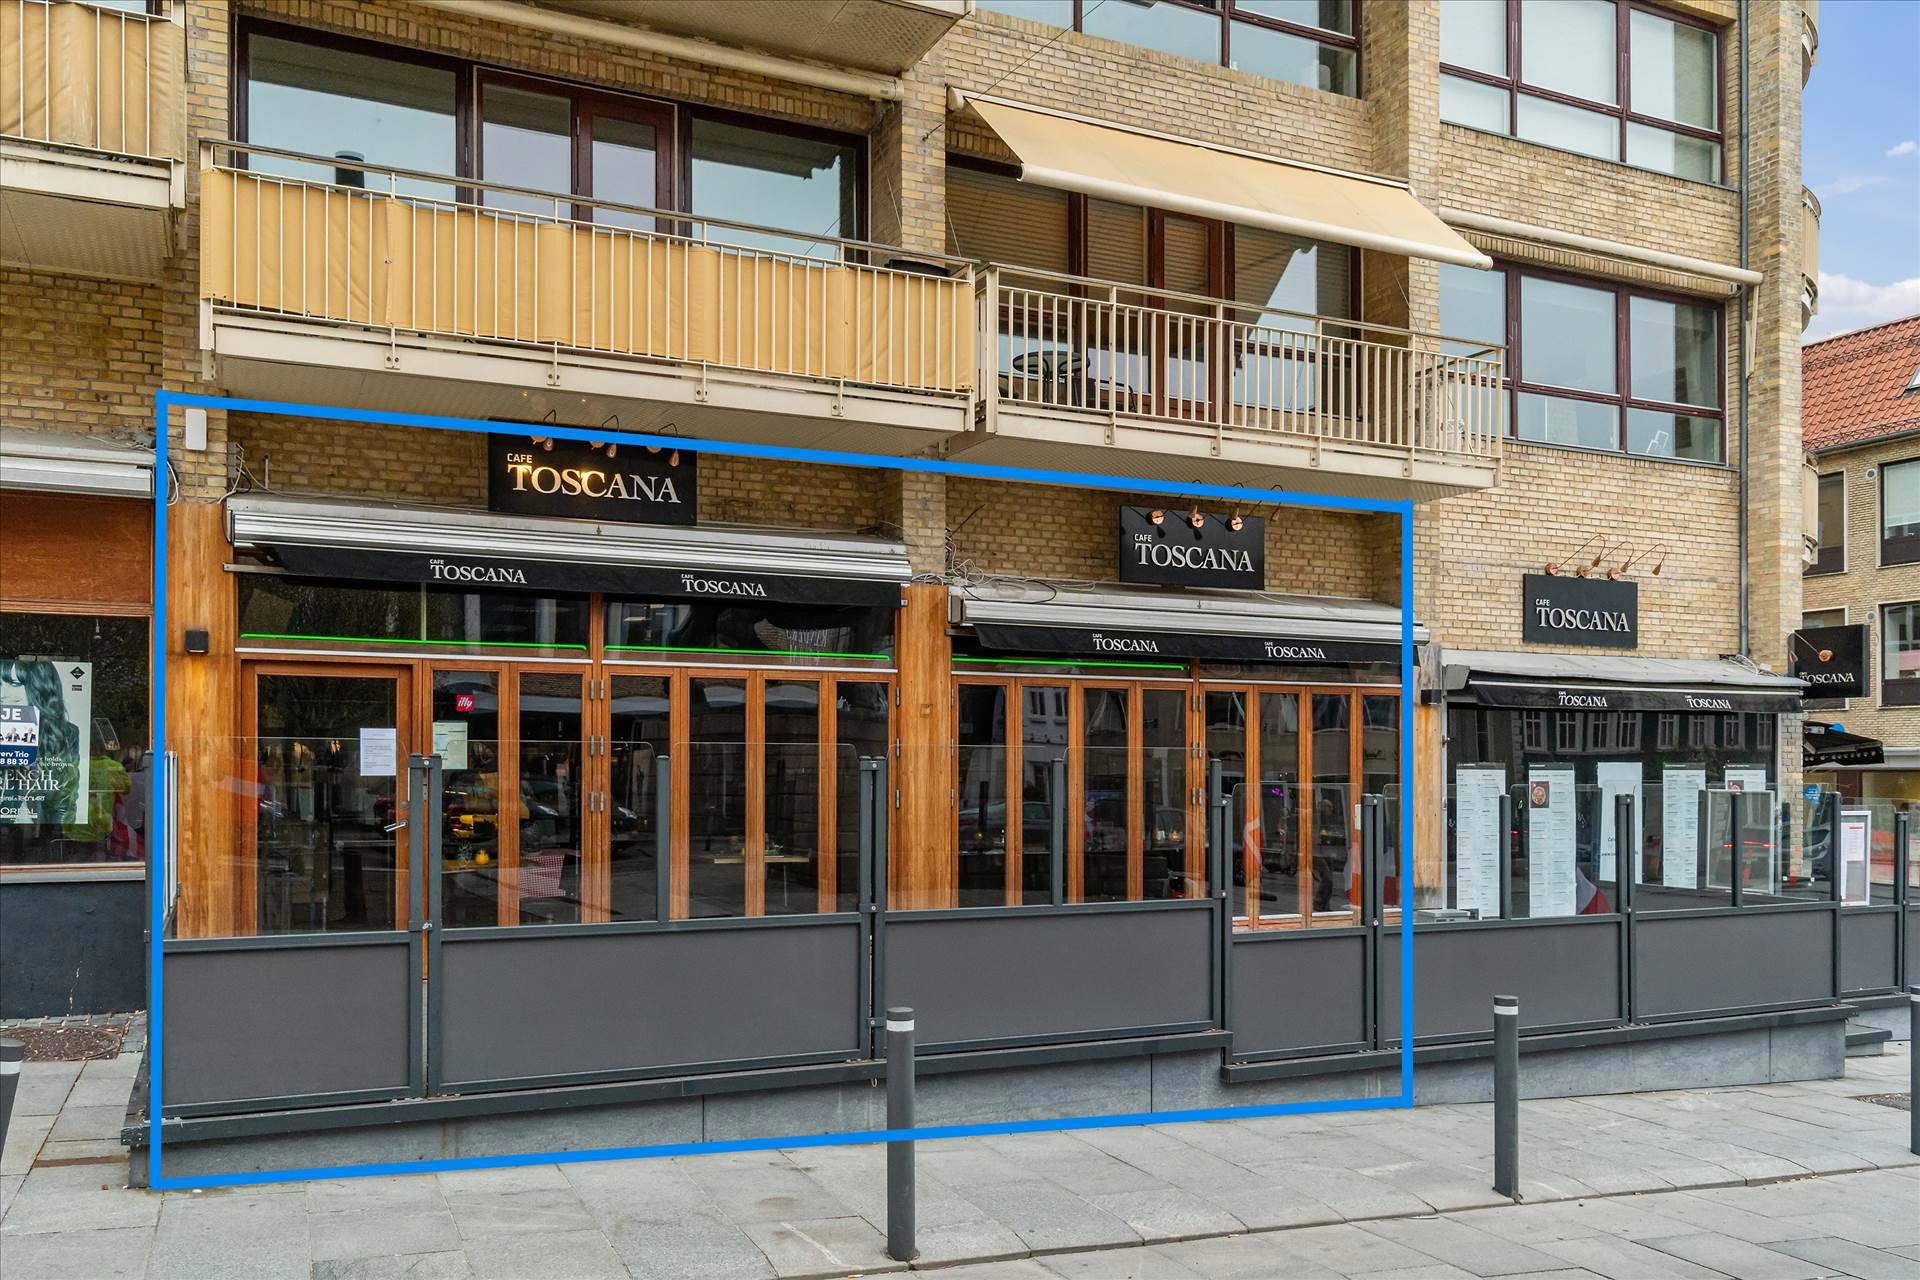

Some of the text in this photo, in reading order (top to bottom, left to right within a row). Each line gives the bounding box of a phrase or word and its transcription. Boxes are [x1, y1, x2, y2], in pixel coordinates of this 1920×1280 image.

[507, 453, 533, 464] CAFE
[507, 464, 682, 504] TOSCANA
[1134, 533, 1152, 542] CAFE
[1134, 543, 1256, 572] TOSCANA
[430, 564, 528, 584] TOSCANA
[681, 579, 768, 597] TOSCANA
[1536, 598, 1550, 606] CAFE
[1536, 607, 1631, 632] TOSCANA
[1093, 638, 1160, 653] TOSCANA
[1264, 645, 1327, 659] TOSCANA
[458, 696, 473, 709] illy
[1558, 695, 1608, 708] TOSCANA
[1686, 698, 1732, 709] TOSCANA
[0, 707, 22, 721] JE
[14, 750, 30, 758] Trio
[18, 758, 29, 766] 30
[0, 769, 53, 781] ENCH
[19, 778, 61, 791] HAIR
